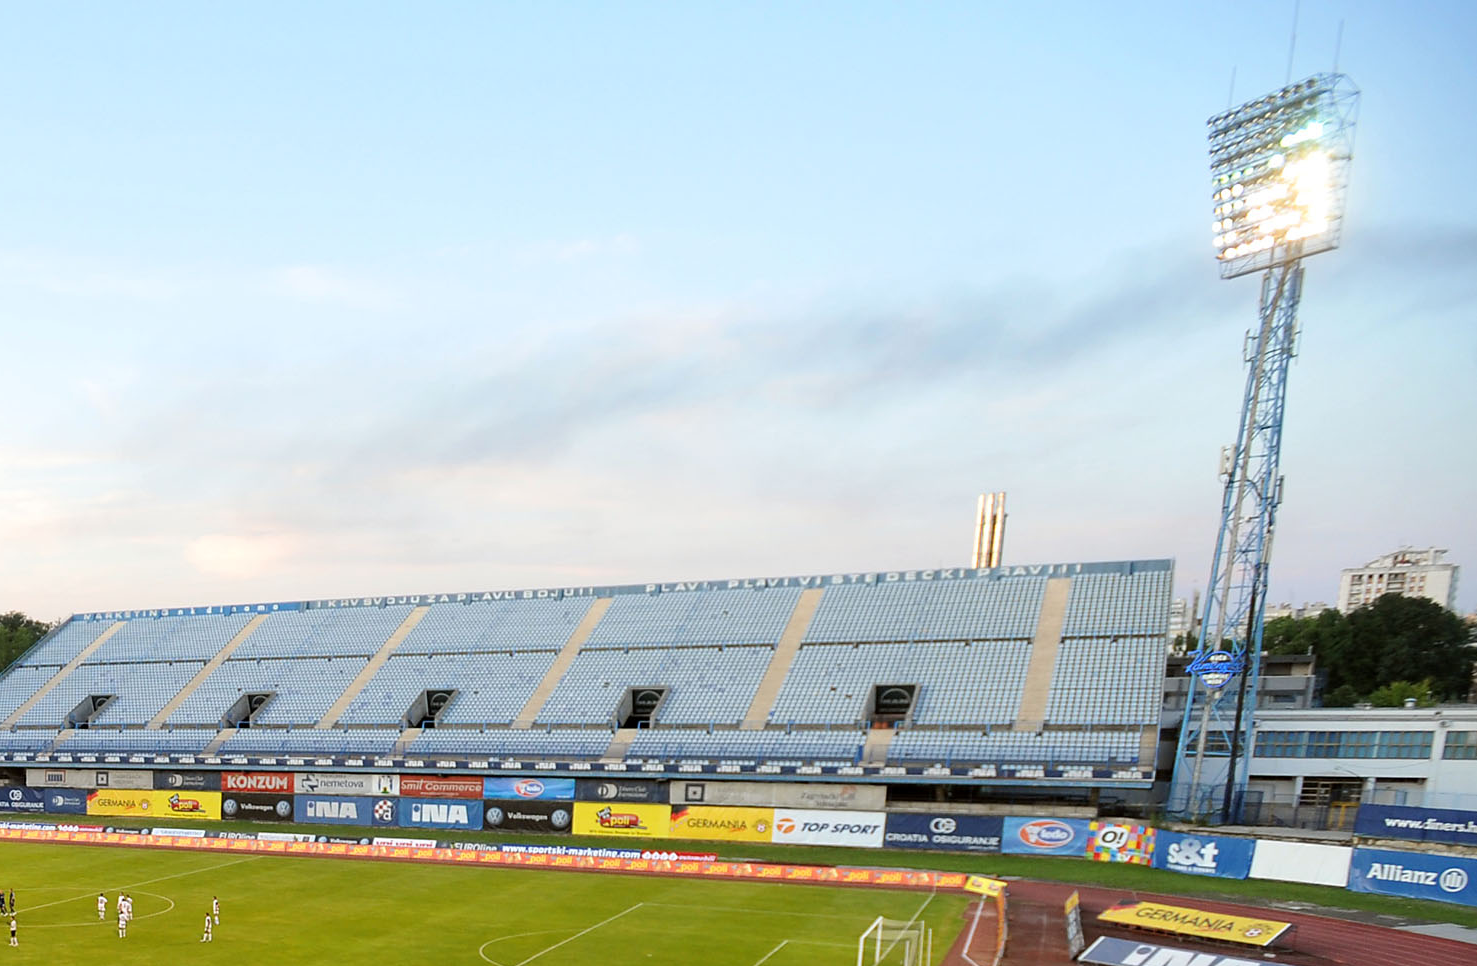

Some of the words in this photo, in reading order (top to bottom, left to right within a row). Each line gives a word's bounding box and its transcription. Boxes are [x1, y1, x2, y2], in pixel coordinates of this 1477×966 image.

[228, 776, 288, 790] KONZUM
[320, 778, 364, 788] nemetova
[426, 782, 482, 792] Commerce
[98, 798, 136, 808] GERMANIA
[240, 804, 273, 812] Volkswagen
[507, 812, 548, 822] Volkswagen
[610, 816, 630, 826] poli
[687, 818, 748, 829] GERMANIA
[801, 822, 828, 832] TOP
[831, 824, 881, 834] SPORT
[1385, 818, 1477, 832] www.diners.h
[886, 832, 928, 842] CROATIA
[932, 834, 1001, 846] OSIGURANJE
[1041, 828, 1068, 839] ledo
[1367, 863, 1438, 885] Allianz
[1136, 907, 1234, 933] GERMANIA
